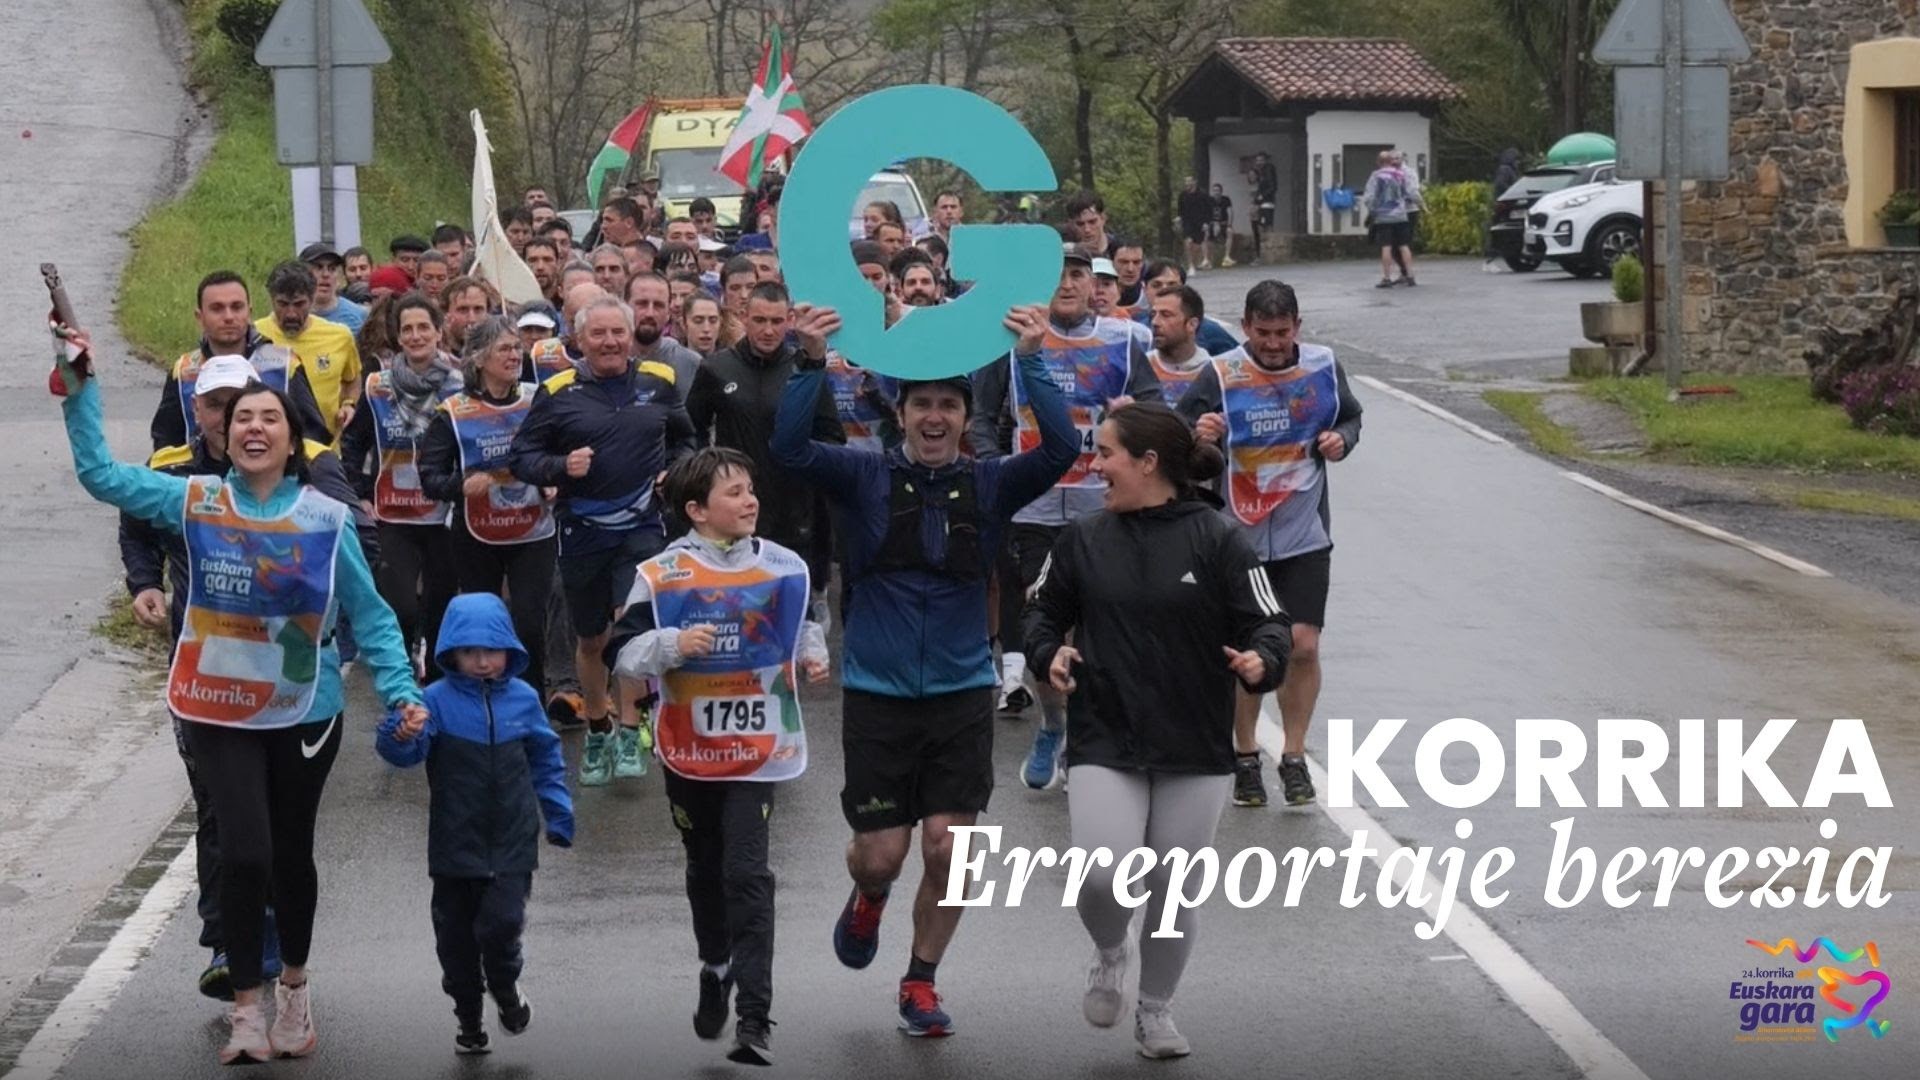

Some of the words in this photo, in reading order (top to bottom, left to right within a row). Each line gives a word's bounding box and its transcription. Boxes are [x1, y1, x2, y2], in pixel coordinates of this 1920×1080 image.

[779, 86, 1064, 380] G
[1252, 418, 1291, 438] gara
[200, 558, 253, 578] Euskara
[205, 573, 252, 595] gara
[174, 679, 257, 709] 24.korrika
[703, 700, 767, 732] 1795
[667, 741, 759, 763] 24.korrika
